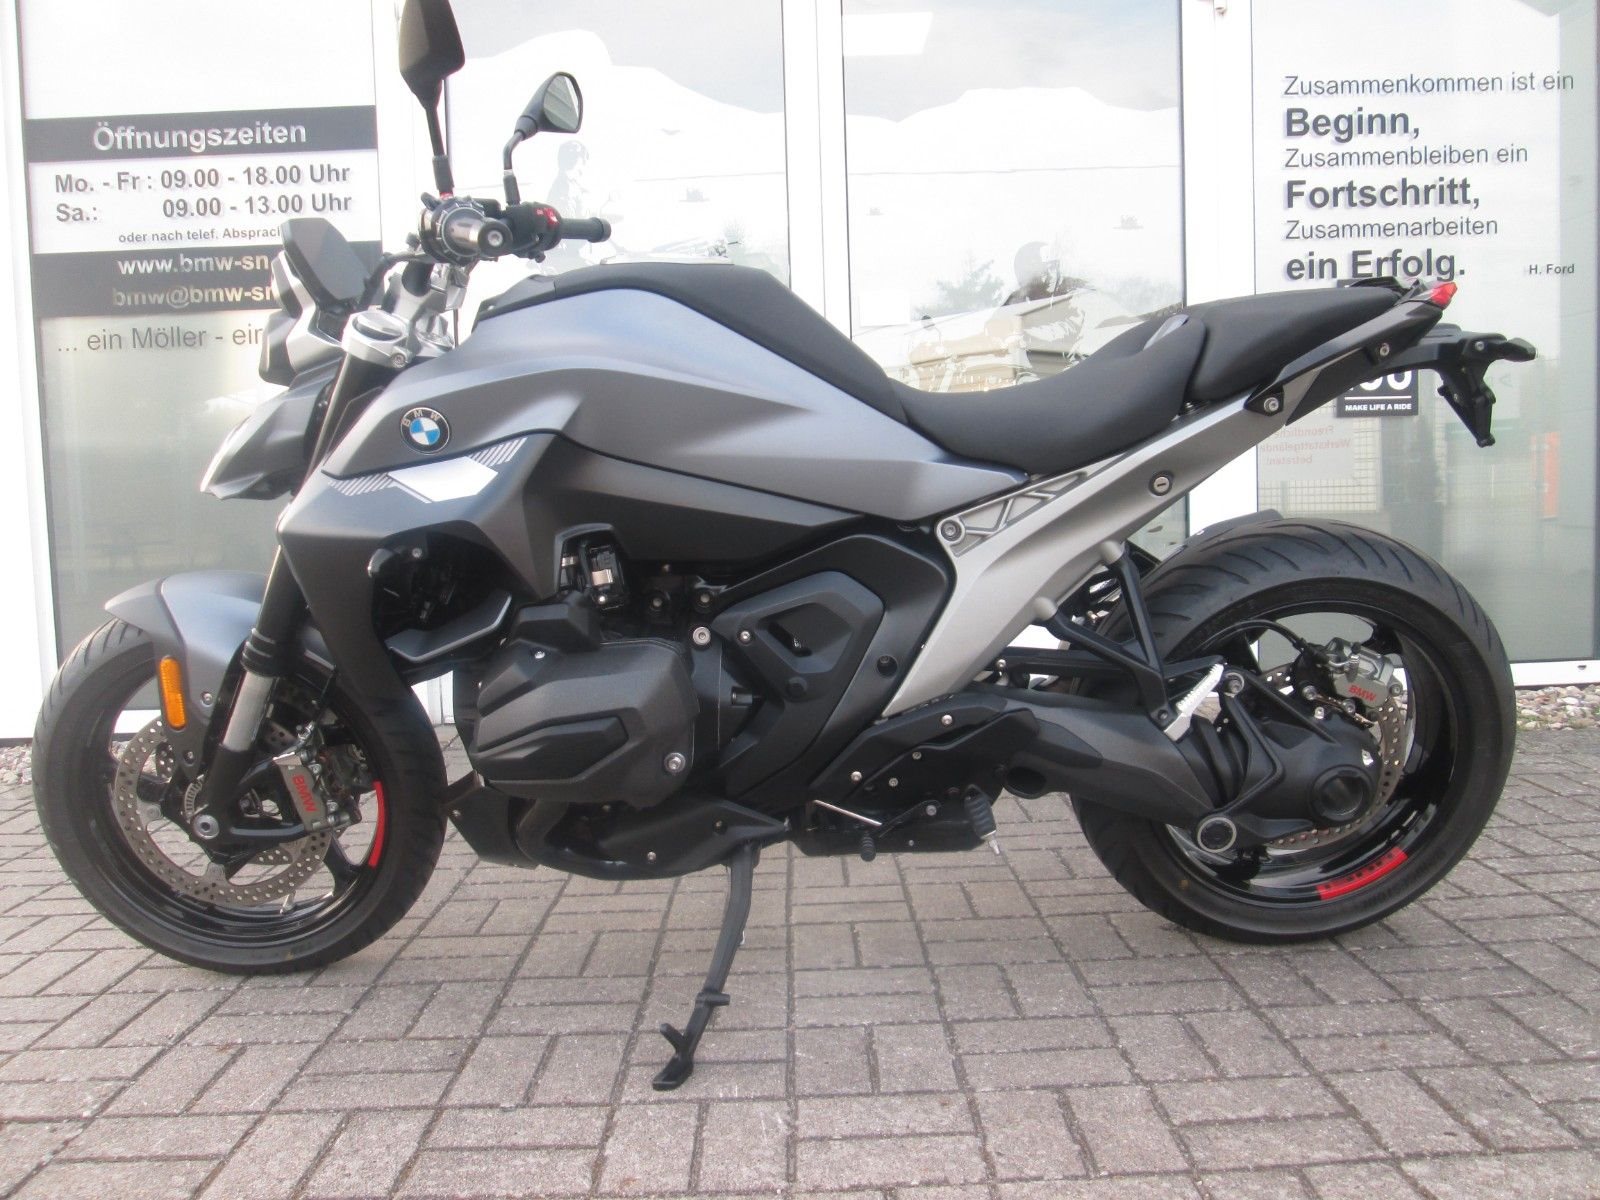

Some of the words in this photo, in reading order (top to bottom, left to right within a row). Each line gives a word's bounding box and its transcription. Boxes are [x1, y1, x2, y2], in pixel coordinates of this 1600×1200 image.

[1284, 73, 1503, 95] Zusammenkommen
[1511, 72, 1535, 91] ist
[1543, 71, 1575, 90] ein
[93, 121, 306, 152] Öffnungszeiten
[1285, 107, 1420, 143] Beginn,
[1284, 145, 1488, 168] Zusammenbleiben
[1496, 144, 1528, 163] ein
[55, 174, 94, 193] Mo.
[161, 168, 219, 188] 09.00
[243, 165, 301, 185] 18.00
[309, 164, 350, 183] Uhr
[1286, 177, 1480, 209] Fortschritt,
[56, 203, 98, 222] Sa.:
[163, 197, 221, 217] 09.00
[245, 194, 303, 214] 13.00
[311, 193, 352, 212] Uhr
[118, 232, 146, 243] oder
[152, 230, 182, 241] nach
[186, 228, 219, 240] telef.
[1285, 217, 1498, 240] Zusammenarbeiten
[1286, 251, 1338, 280] ein
[1351, 248, 1466, 281] Erfolg.
[1528, 264, 1542, 275] H.
[1546, 263, 1575, 275] Ford
[87, 329, 122, 350] ein
[132, 327, 207, 349] Möller
[402, 409, 441, 428] BMW
[1348, 684, 1377, 702] BMW
[292, 775, 318, 812] BMW
